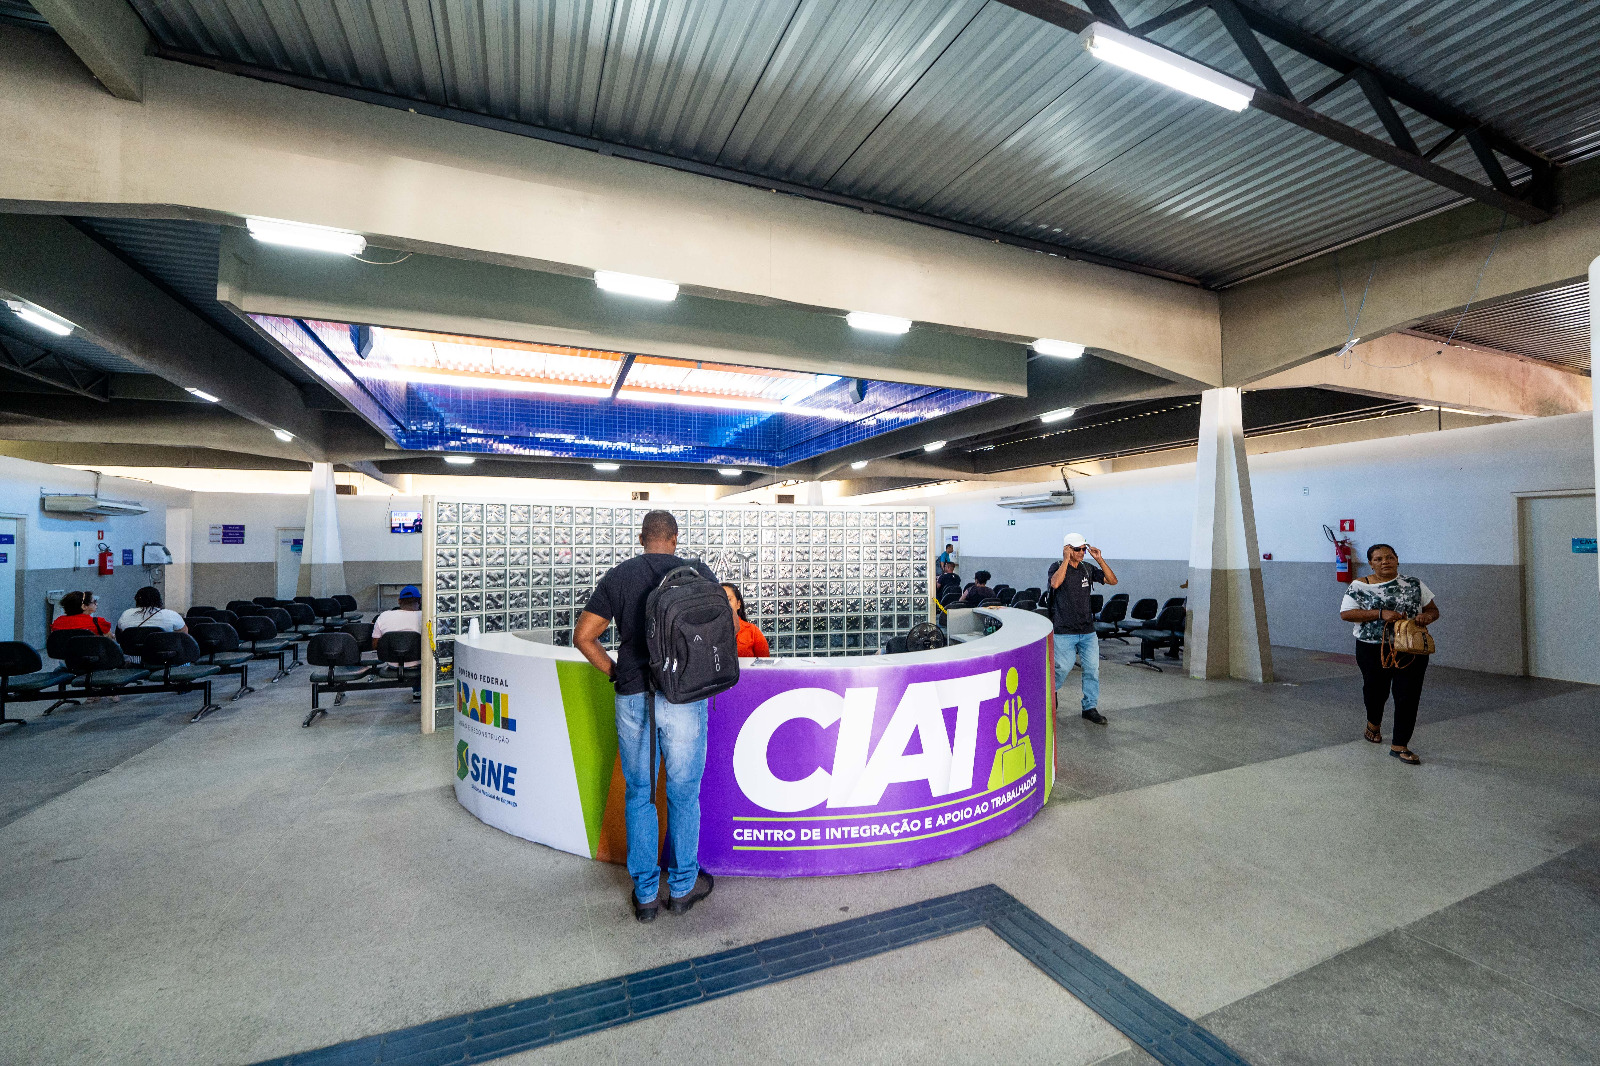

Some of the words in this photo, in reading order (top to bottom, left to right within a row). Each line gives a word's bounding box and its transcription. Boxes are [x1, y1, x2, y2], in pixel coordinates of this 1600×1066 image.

[456, 678, 517, 732] BRASIL
[479, 674, 509, 687] FEDERAL
[732, 669, 1002, 813] CIAT
[732, 828, 796, 842] CENTRO
[800, 828, 821, 841] DE
[825, 818, 922, 840] INTEGRAÇÃO
[924, 816, 933, 829] E
[935, 806, 973, 827] APOIO
[973, 801, 989, 817] AO
[990, 773, 1037, 810] TRABALHADOR
